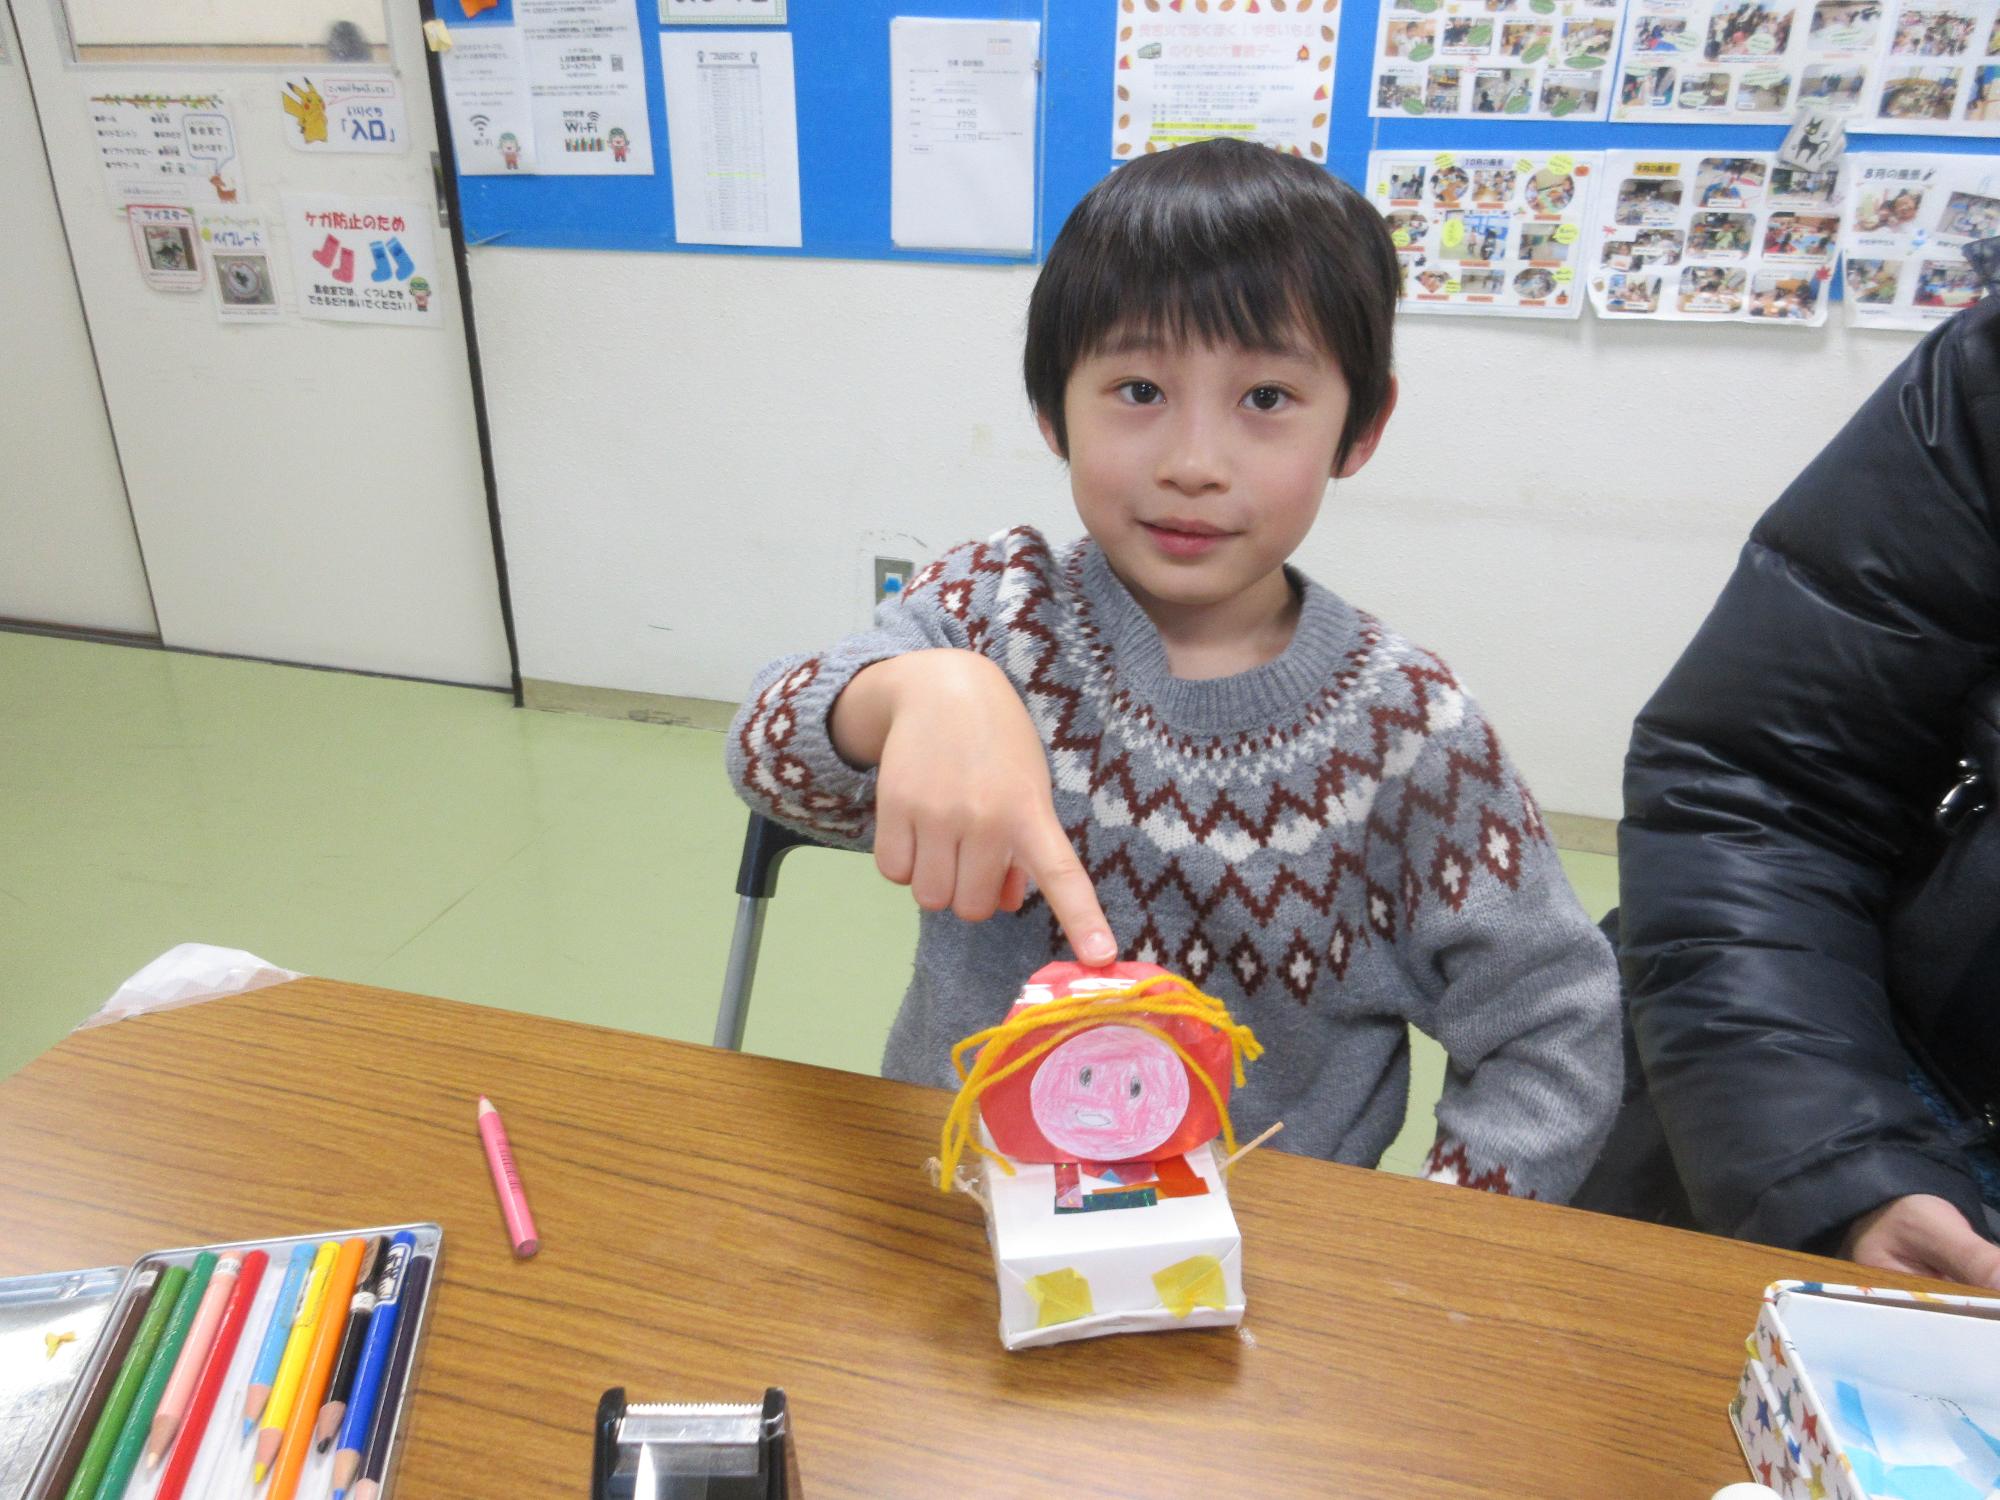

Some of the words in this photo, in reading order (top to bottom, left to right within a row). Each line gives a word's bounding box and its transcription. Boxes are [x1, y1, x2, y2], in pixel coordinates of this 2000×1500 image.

[341, 118, 396, 142] 「入口」
[565, 122, 597, 133] Wi-Fi
[305, 210, 406, 232] ケガ防止のため
